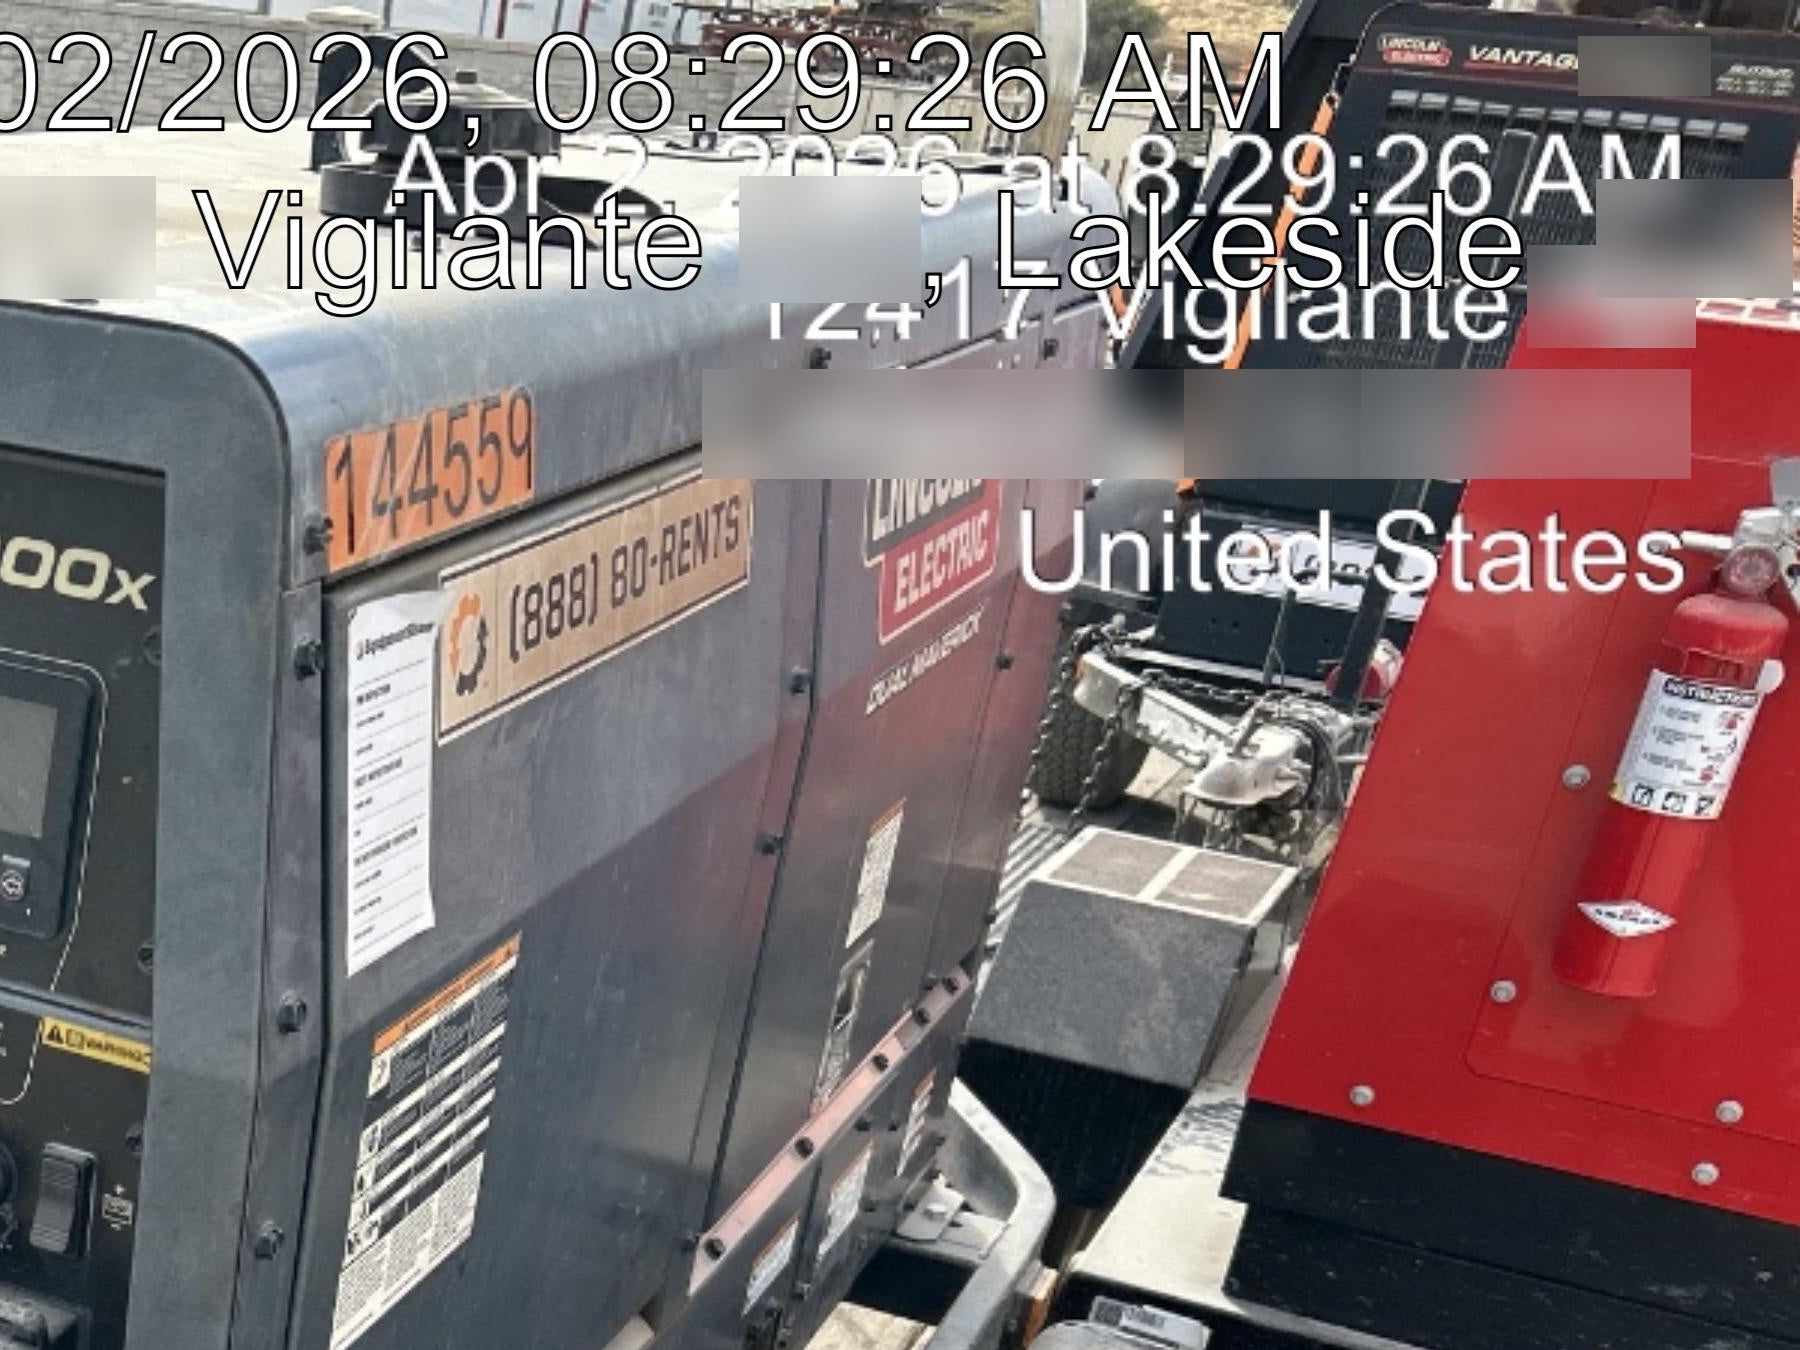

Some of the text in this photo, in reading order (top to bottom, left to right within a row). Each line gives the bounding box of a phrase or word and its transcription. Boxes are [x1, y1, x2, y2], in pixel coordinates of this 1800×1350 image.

[1469, 44, 1579, 71] VANTAG
[334, 384, 532, 556] 144559
[871, 479, 983, 542] LINC
[507, 494, 741, 664] (888) 80-RENTS
[895, 508, 990, 614] ELECTRIC
